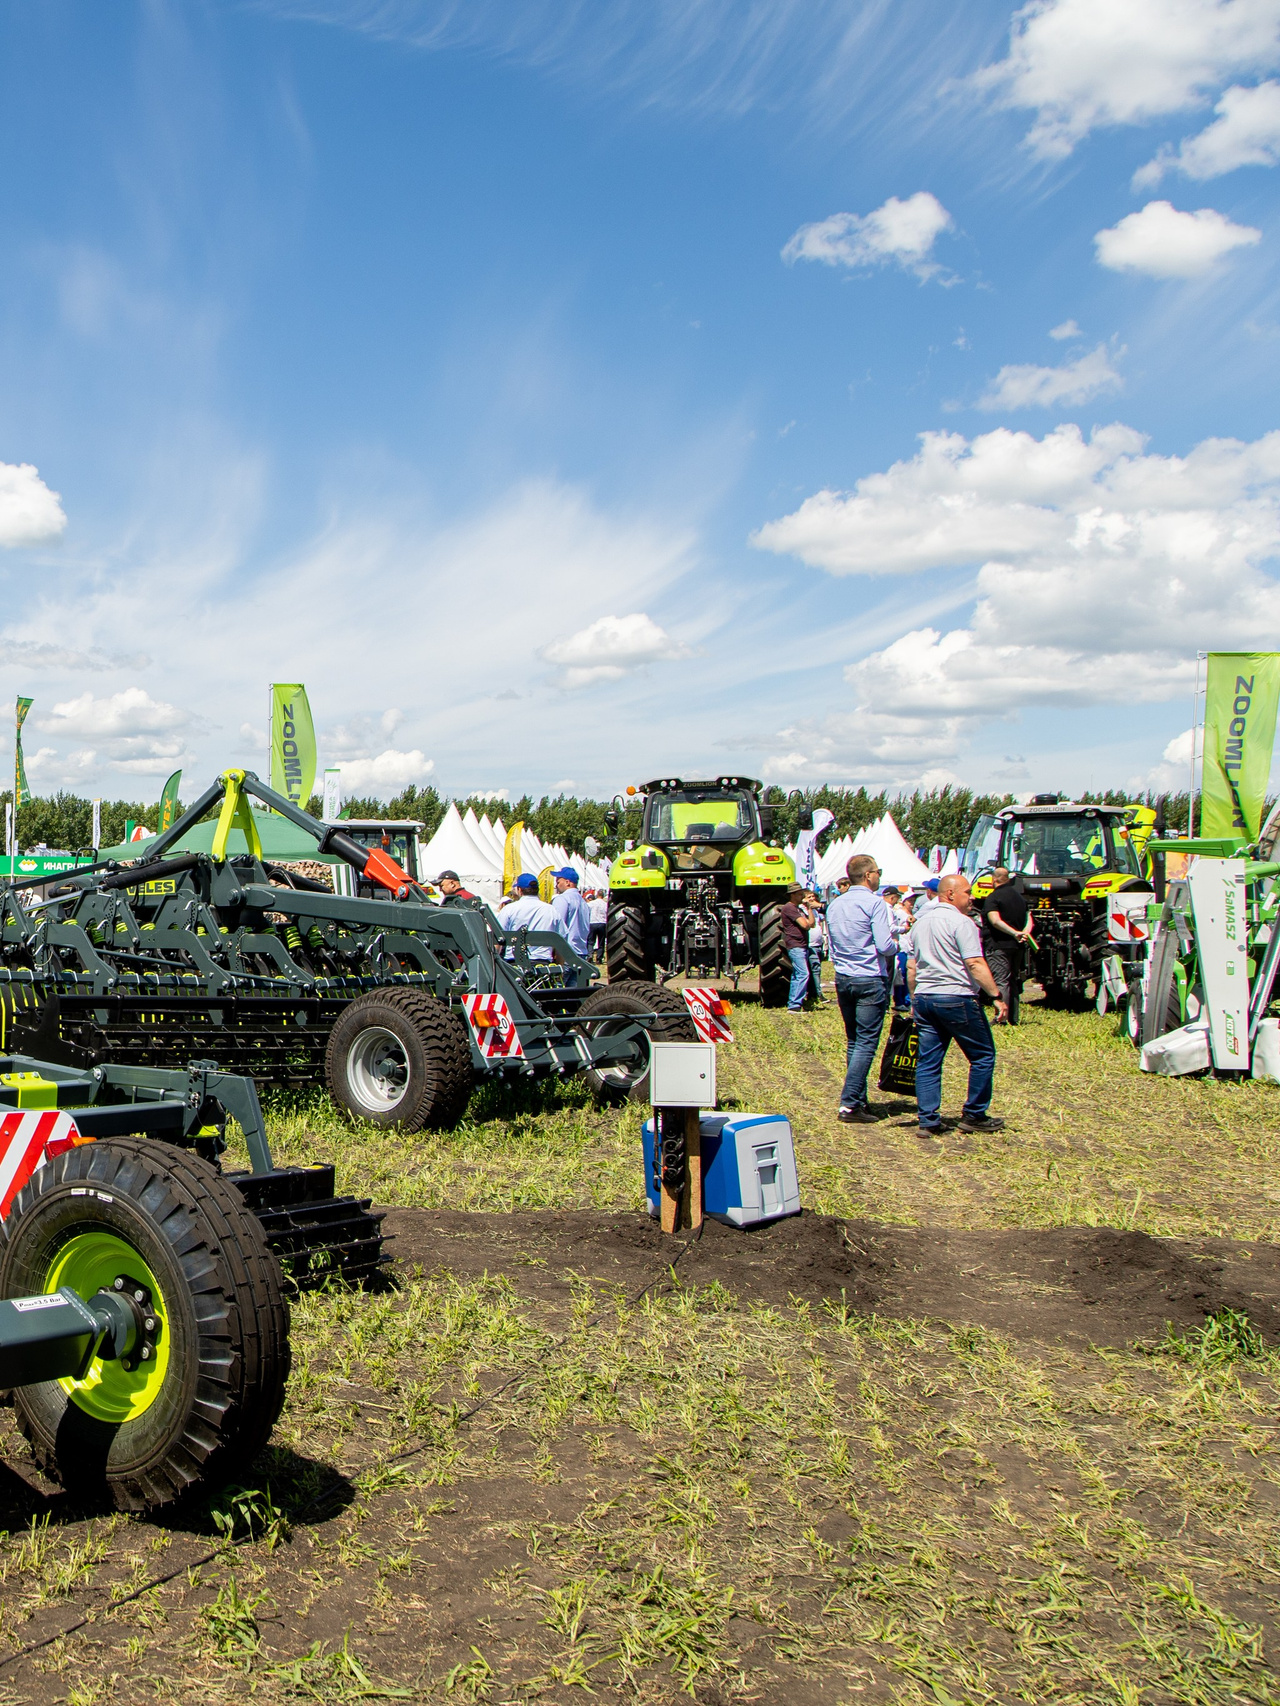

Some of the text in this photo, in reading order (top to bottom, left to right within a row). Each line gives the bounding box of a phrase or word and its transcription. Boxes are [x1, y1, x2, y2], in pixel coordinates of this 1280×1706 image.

[282, 703, 303, 807] ZOOMLI
[162, 799, 173, 832] TEX
[126, 881, 175, 894] VELES
[1224, 890, 1237, 941] SaMASZ
[695, 1004, 705, 1015] 20
[893, 1054, 917, 1068] FJD.
